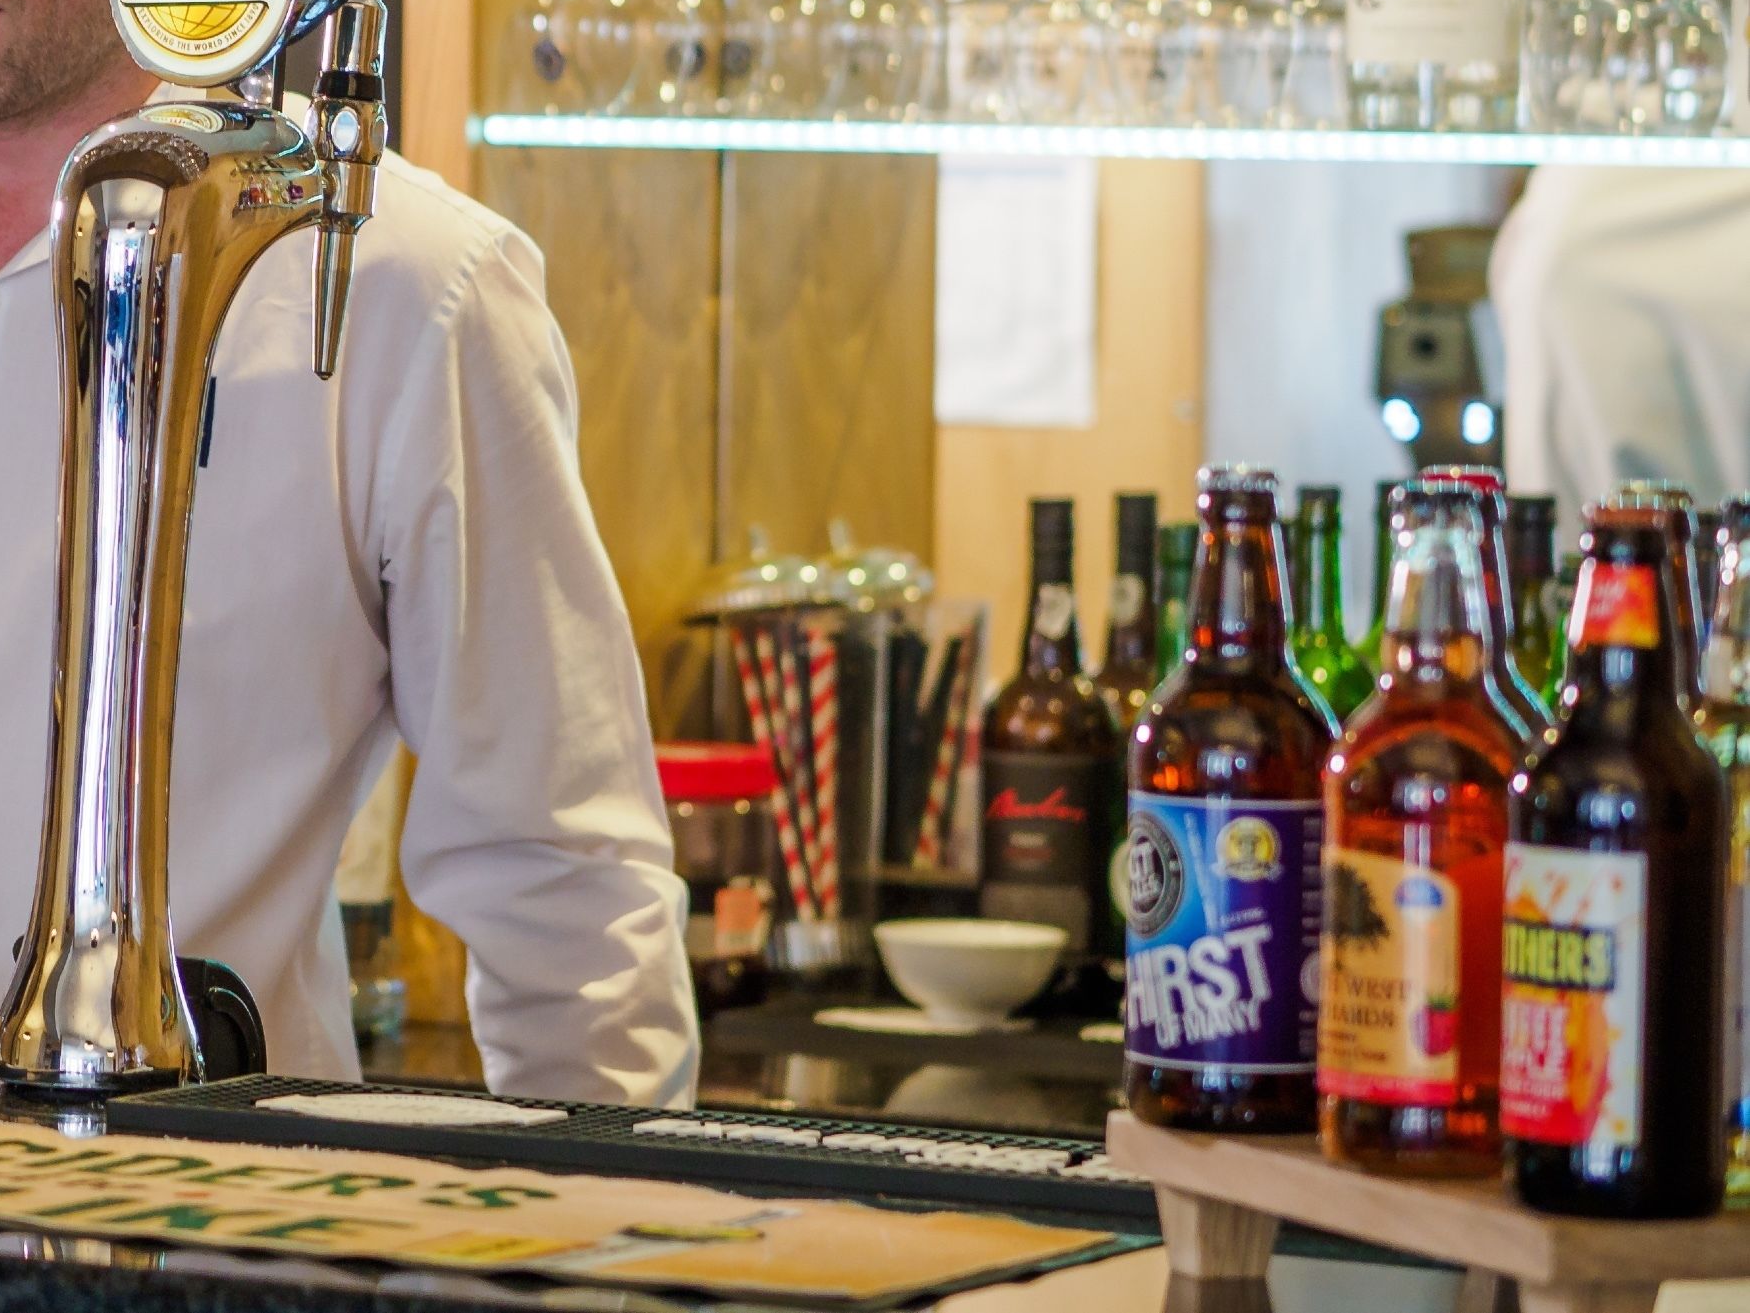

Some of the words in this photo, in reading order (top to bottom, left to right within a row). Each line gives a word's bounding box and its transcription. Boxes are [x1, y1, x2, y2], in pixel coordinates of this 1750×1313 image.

[138, 8, 175, 46] EXPLORING
[177, 39, 191, 51] THE
[193, 39, 223, 52] WORLD
[224, 23, 247, 43] SINCE
